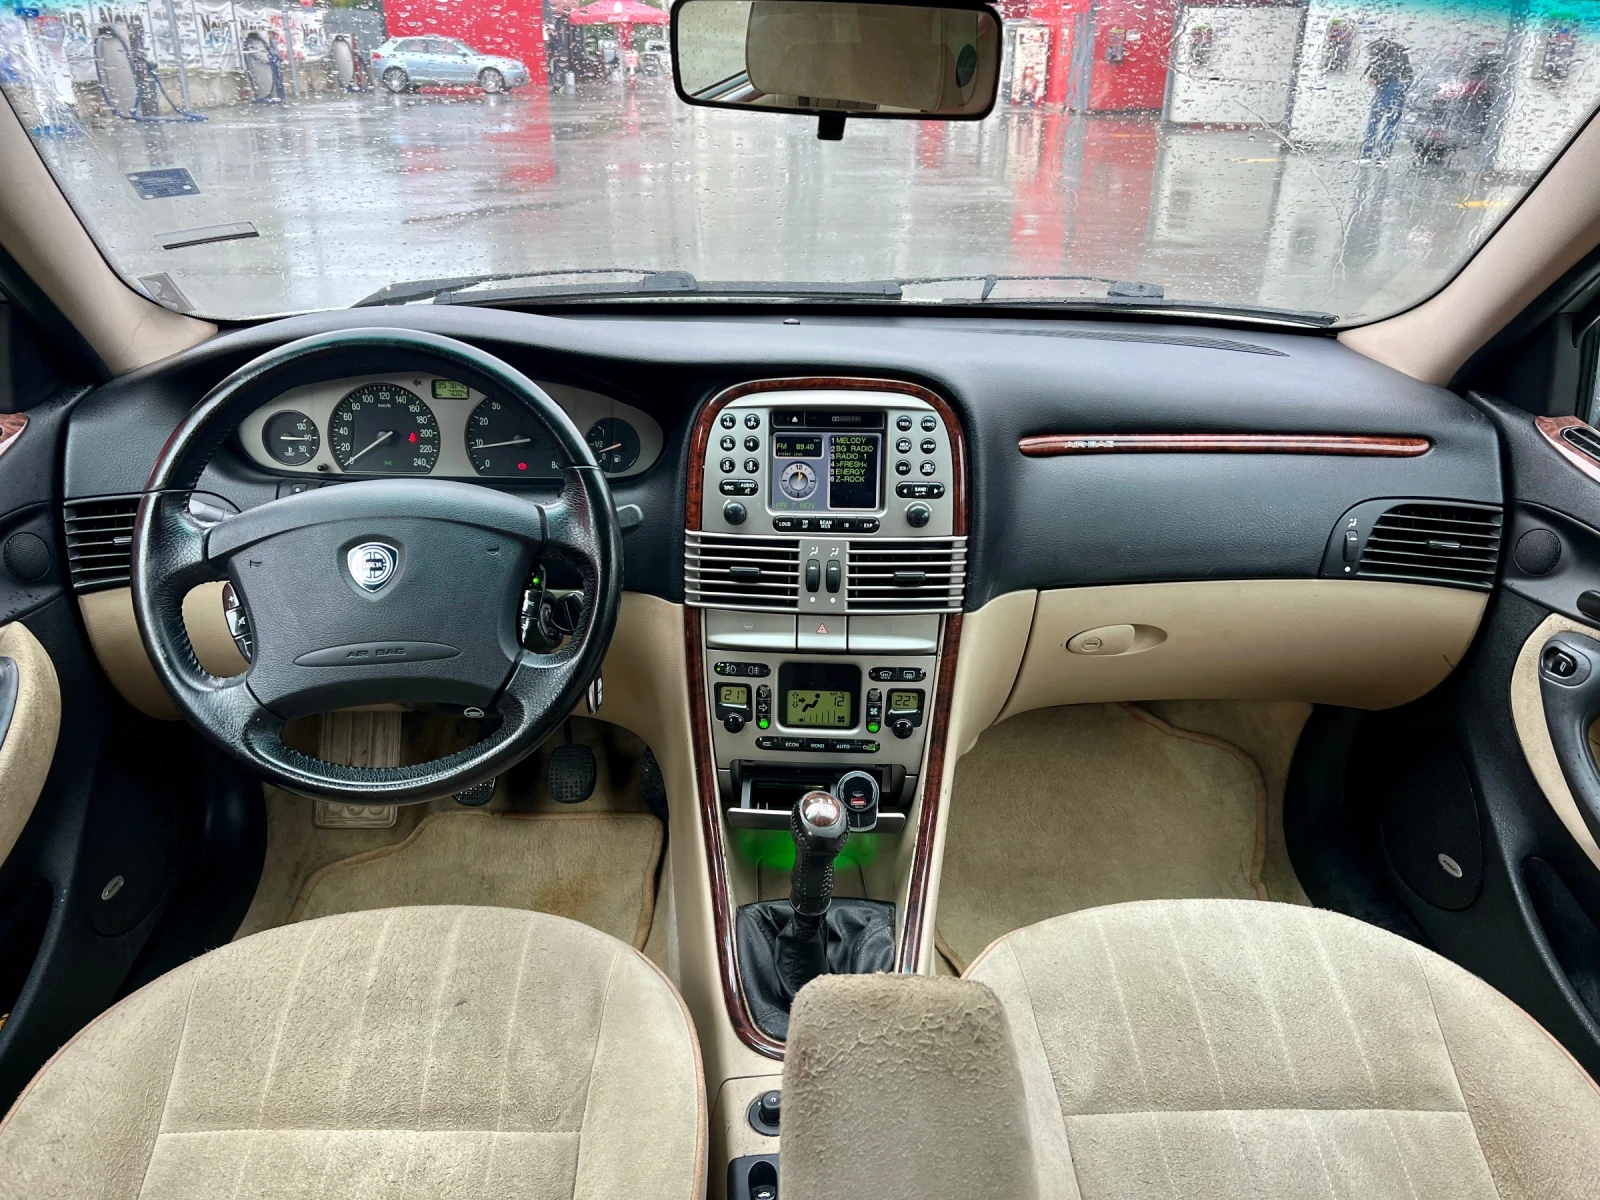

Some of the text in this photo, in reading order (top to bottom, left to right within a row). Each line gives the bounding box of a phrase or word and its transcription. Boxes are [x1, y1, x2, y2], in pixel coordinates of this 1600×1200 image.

[362, 395, 374, 403] 100
[379, 392, 390, 400] 120
[395, 396, 407, 404] 140
[352, 402, 360, 410] 80
[408, 404, 420, 413] 160
[343, 413, 352, 421] 60
[416, 415, 428, 424] 180
[479, 417, 489, 425] 20
[339, 427, 348, 435] 40
[420, 430, 433, 438] 200
[475, 438, 484, 446] 10
[594, 440, 604, 448] 1/2
[1064, 440, 1085, 448] AIR
[341, 443, 350, 451] 20
[419, 445, 432, 453] 220
[413, 458, 426, 466] 240
[346, 648, 406, 658] AIR BAG
[724, 690, 740, 700] 21
[895, 695, 910, 706] 22
